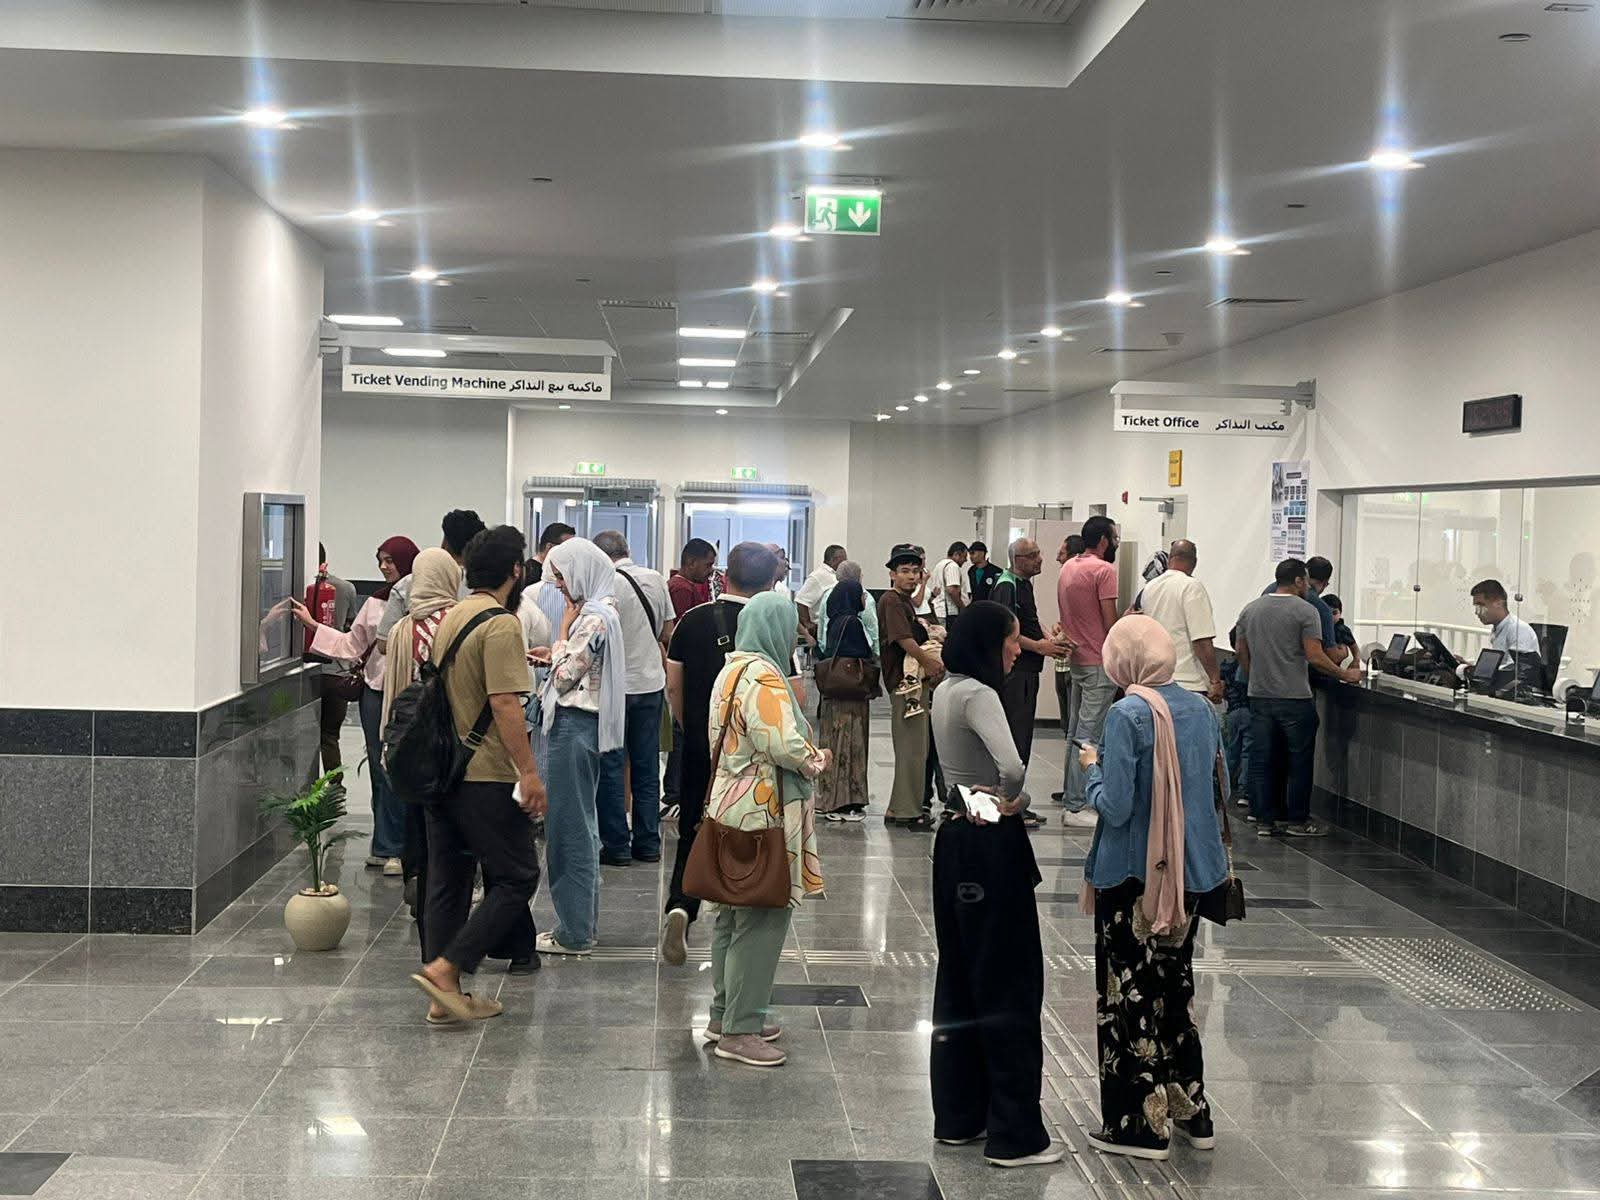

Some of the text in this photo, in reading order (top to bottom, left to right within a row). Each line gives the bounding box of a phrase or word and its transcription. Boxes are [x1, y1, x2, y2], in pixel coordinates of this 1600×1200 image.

[352, 373, 507, 390] Ticket Vending Machine
[509, 379, 545, 392] التذاكر
[1121, 415, 1200, 428] Ticket Office
[1215, 418, 1285, 431] مكتب التذاكر
